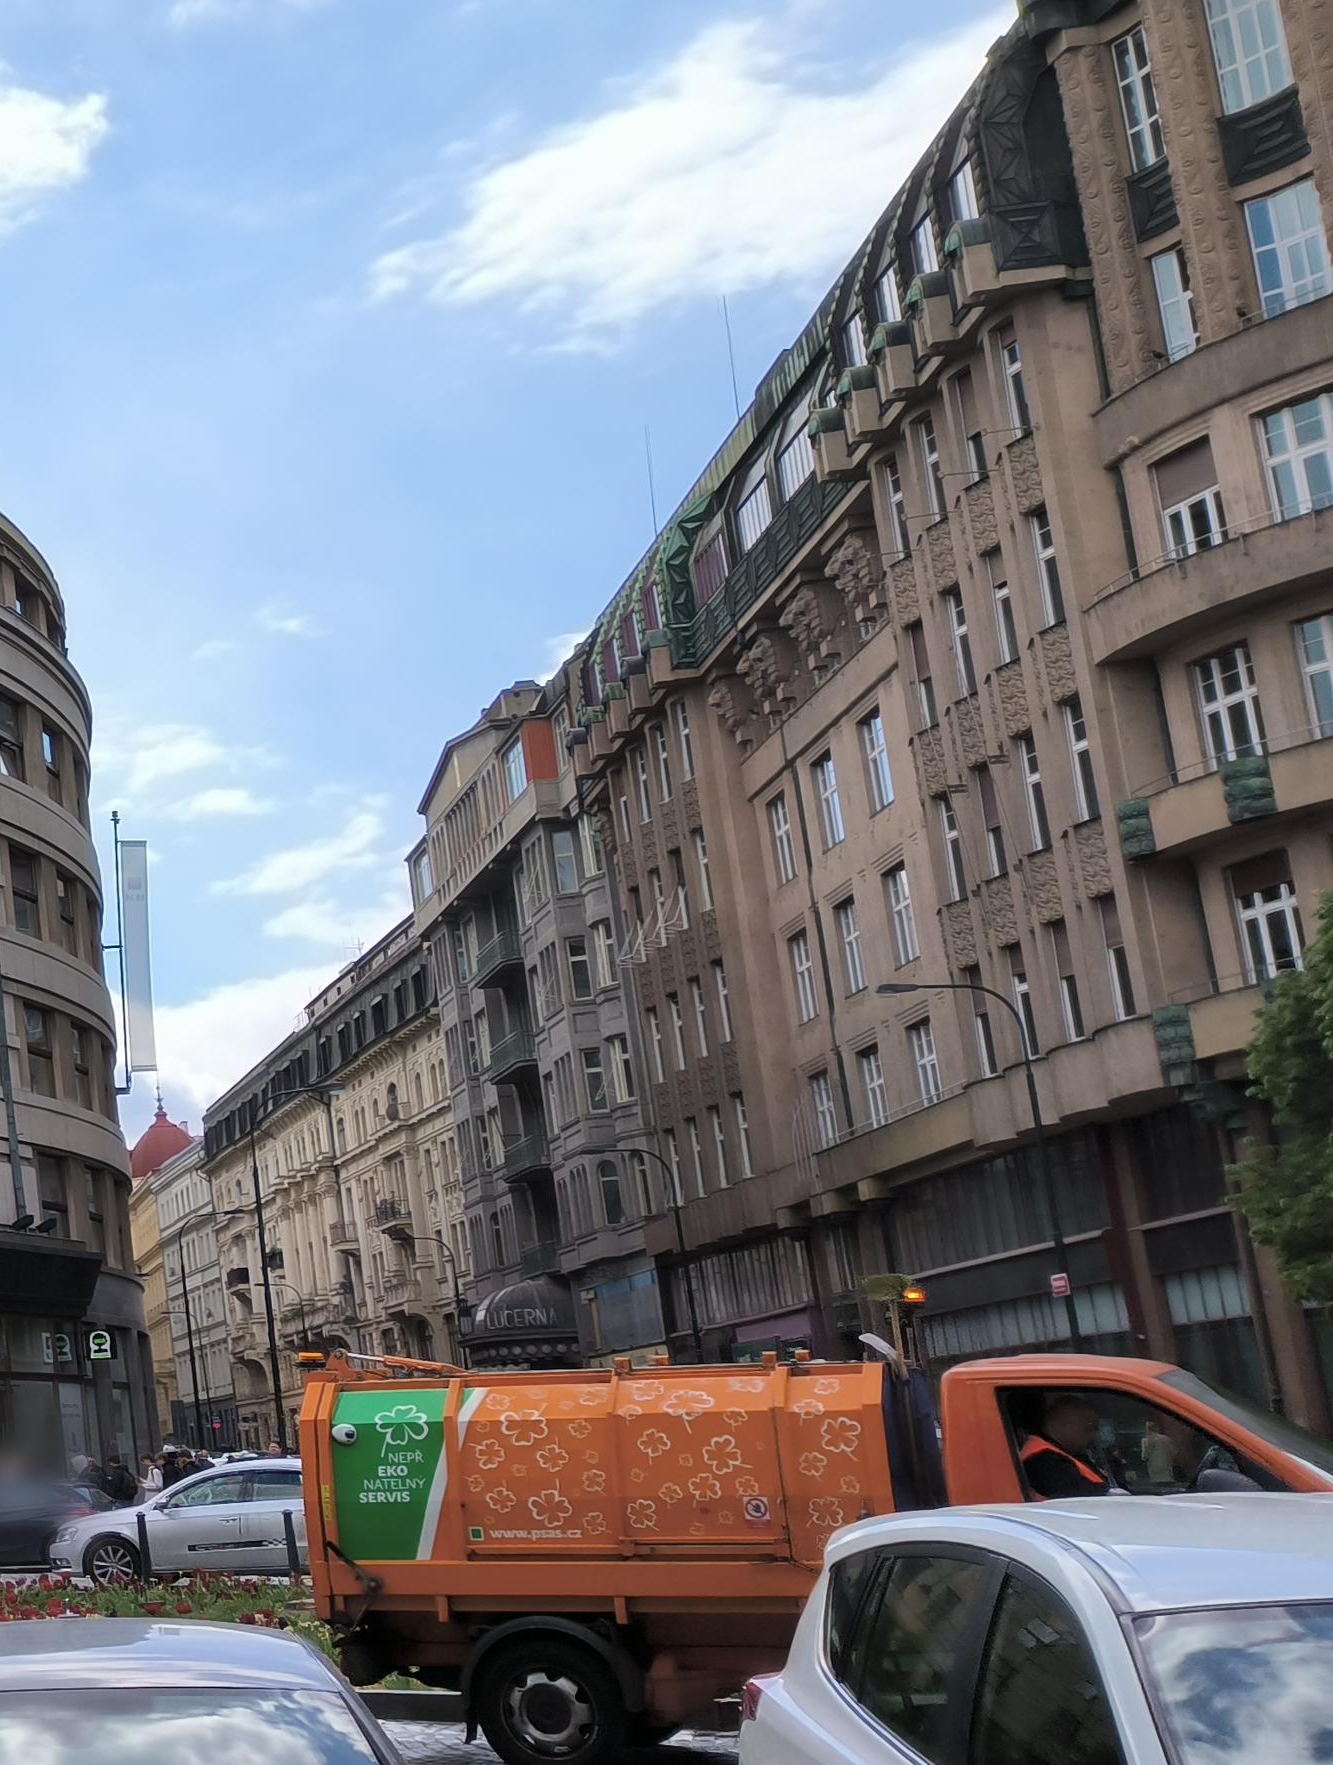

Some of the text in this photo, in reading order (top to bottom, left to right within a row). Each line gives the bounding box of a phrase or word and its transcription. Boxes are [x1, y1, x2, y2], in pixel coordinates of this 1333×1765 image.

[486, 1307, 558, 1330] LUCERNA
[388, 1449, 424, 1464] NEPŘ
[378, 1465, 408, 1477] EKO
[363, 1475, 426, 1490] NATELNÝ
[359, 1491, 411, 1503] SERVIS
[489, 1529, 582, 1541] www.psas.cz
